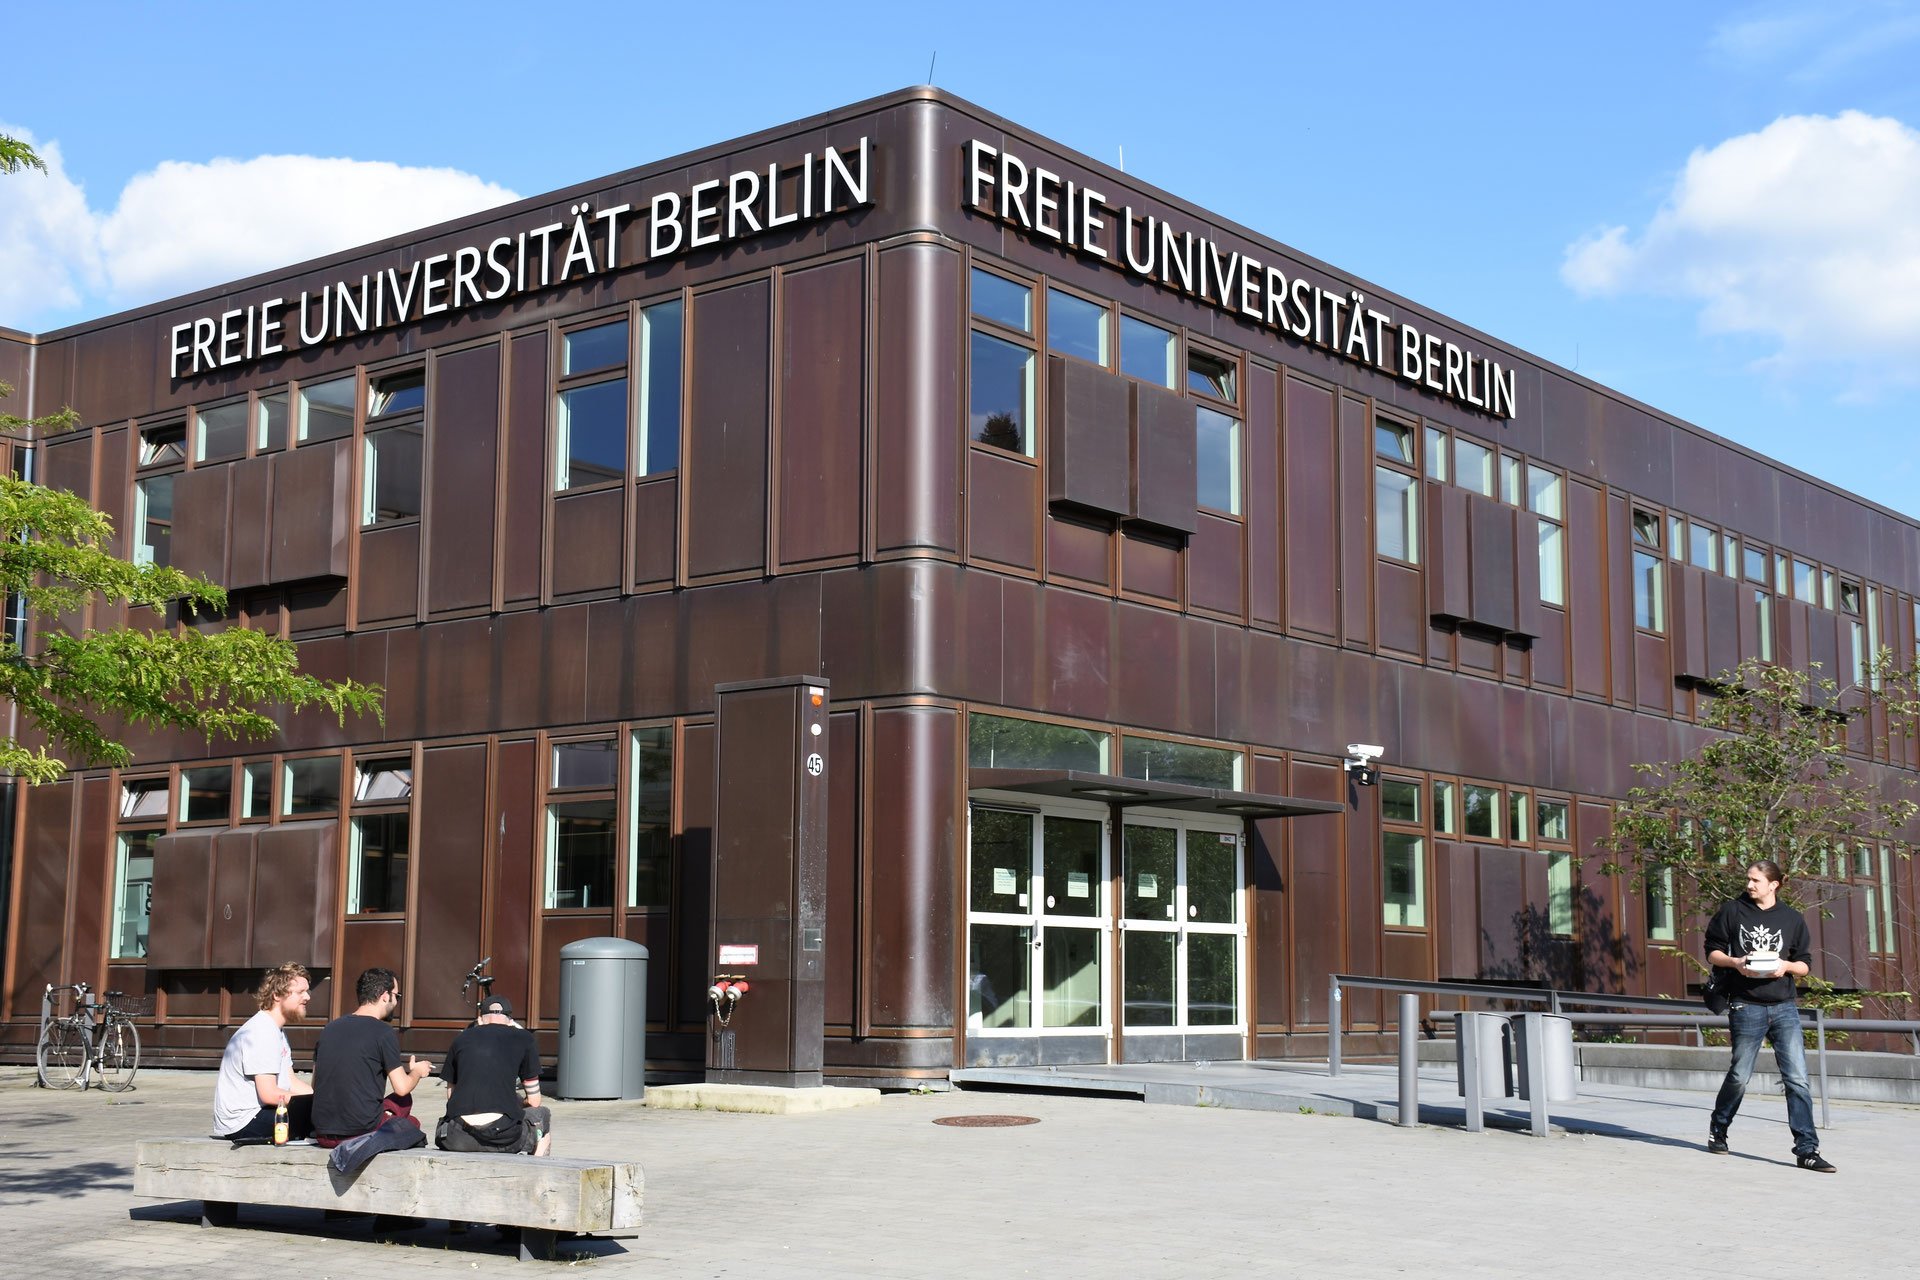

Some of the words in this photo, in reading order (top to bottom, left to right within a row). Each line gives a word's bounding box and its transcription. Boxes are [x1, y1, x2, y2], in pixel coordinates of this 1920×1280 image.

[171, 297, 284, 379] FREIE
[300, 202, 631, 345] UNIVERSITÄT
[650, 136, 868, 258] BERLIN
[970, 138, 1108, 258] FREIE
[1125, 205, 1391, 367] UNIVERSITÄT
[1402, 323, 1516, 419] BERLIN
[808, 757, 821, 773] 45
